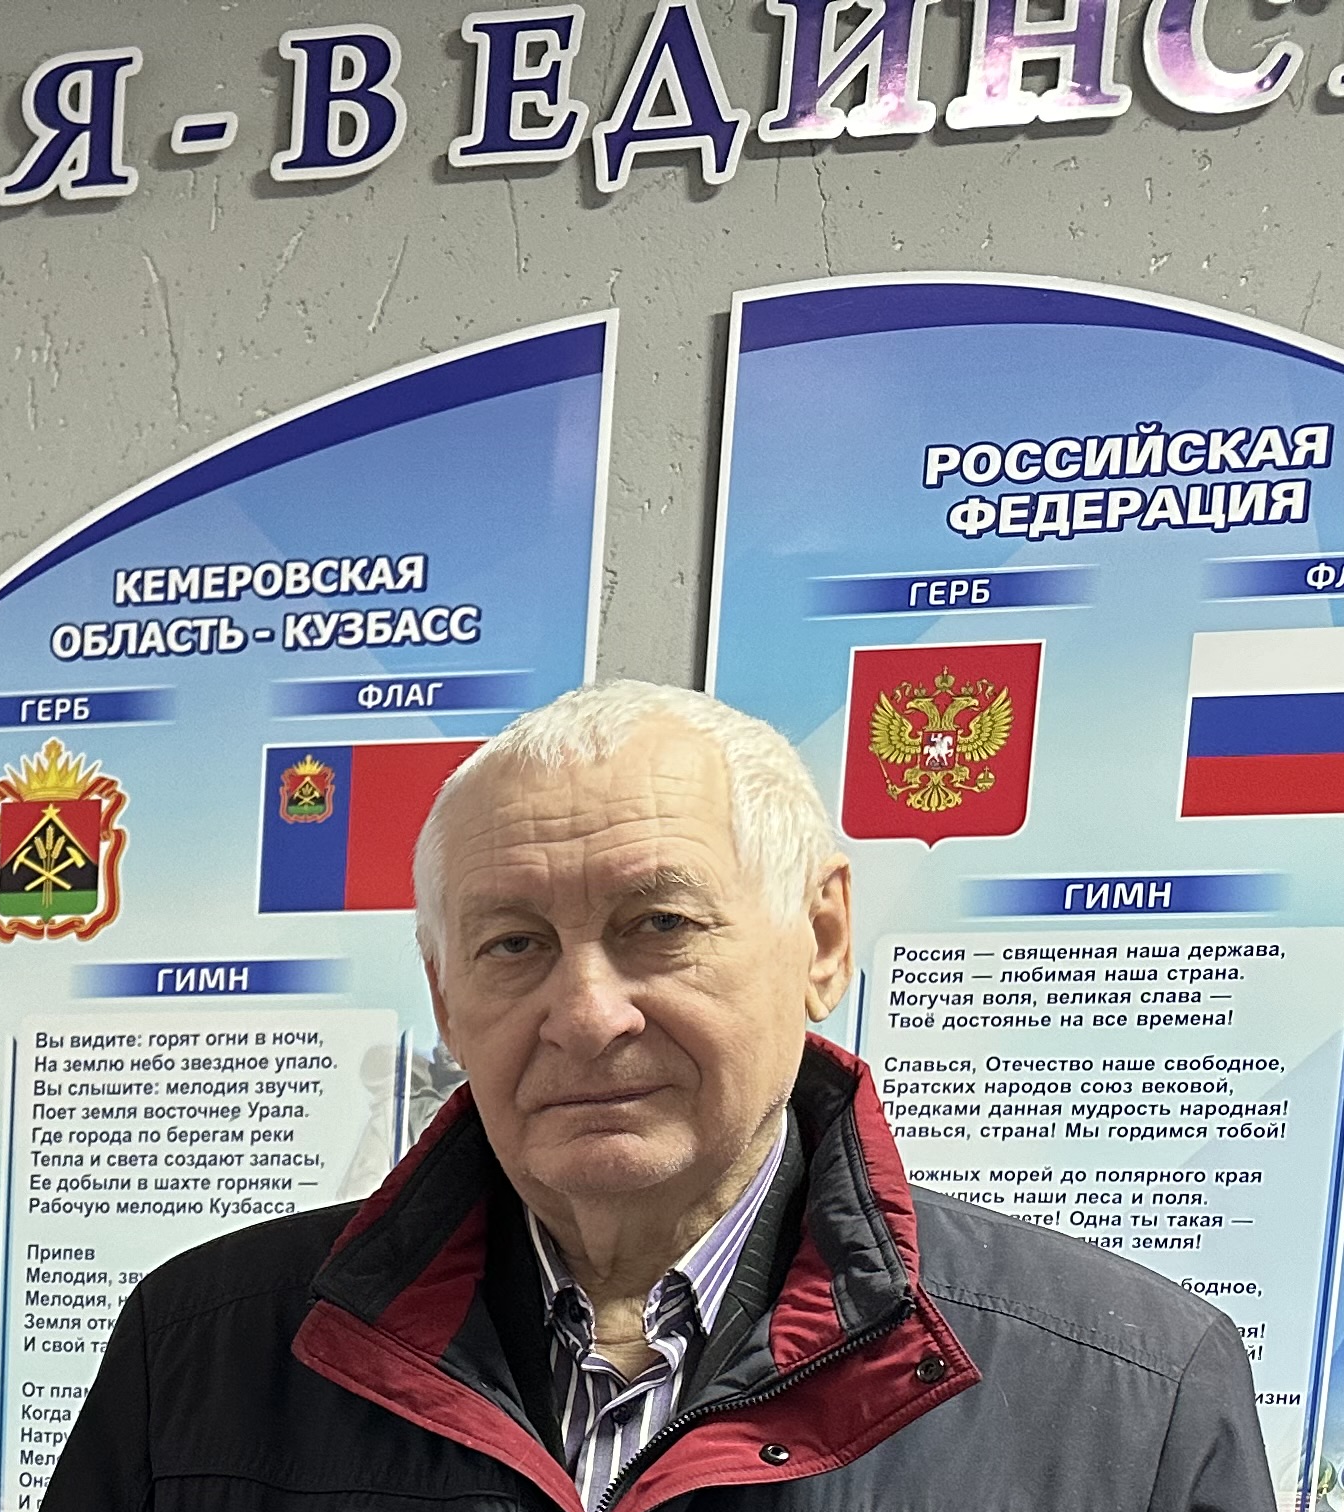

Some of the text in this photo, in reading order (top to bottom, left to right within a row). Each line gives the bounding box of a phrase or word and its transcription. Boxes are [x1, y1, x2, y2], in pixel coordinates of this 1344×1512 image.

[174, 112, 230, 152] -
[278, 22, 408, 180] В
[450, 0, 1344, 190] ЕДИНС
[924, 421, 1333, 486] РОССИЙСКАЯ
[947, 479, 1311, 539] ФЕДЕРАЦИЯ
[114, 555, 425, 603] КЕМЕРОВСКАЯ
[909, 578, 992, 608] ГЕРБ
[52, 615, 245, 660] ОБЛАСТЬ
[282, 606, 480, 650] КУЗБАСС
[357, 681, 443, 709] ФЛАГ
[20, 697, 91, 722] ГЕРБ
[1063, 880, 1173, 910] ГИМН
[892, 945, 966, 962] Россия
[1002, 946, 1118, 962] священная
[1126, 945, 1180, 959] наша
[1187, 944, 1286, 961] держава,
[156, 967, 249, 993] ГИМН
[891, 968, 964, 984] Россия
[1000, 966, 1097, 983] любимая
[1104, 967, 1158, 982] наша
[1166, 966, 1245, 984] страна.
[889, 990, 974, 1009] Могучая
[982, 991, 1038, 1007] воля,
[1046, 991, 1132, 1005] великая
[1140, 989, 1202, 1004] слава
[888, 1009, 1234, 1030] Твоё достоянье на все времена!
[35, 1031, 324, 1051] Вы видите: горят огни в ночи,
[34, 1054, 338, 1074] На землю небо звездное упало.
[884, 1054, 1285, 1075] Славься, Отечество наше свободное,
[33, 1079, 324, 1098] Вы слышите: мелодия звучит,
[882, 1077, 1234, 1098] Братских народов союз вековой,
[32, 1101, 310, 1122] Поет земля восточнее Урала.
[882, 1100, 1289, 1120] Предками данная мудрость народная!
[31, 1126, 295, 1148] Где города по берегам реки
[887, 1121, 1287, 1142] лавься, страна! Мы гордимся тобой!
[30, 1150, 326, 1169] Тепла и света создают запасы,
[29, 1174, 52, 1191] Ее
[56, 1173, 132, 1194] добыли
[137, 1177, 149, 1191] в
[153, 1176, 211, 1191] шахте
[216, 1176, 293, 1195] горняки
[989, 1166, 1054, 1186] морей
[1060, 1169, 1088, 1185] до
[1095, 1169, 1207, 1187] полярного
[1214, 1170, 1264, 1187] края
[28, 1197, 111, 1218] Рабочую
[115, 1200, 204, 1217] мелодию
[1012, 1191, 1067, 1204] наши
[1074, 1192, 1123, 1205] леса
[1131, 1192, 1144, 1205] и
[1151, 1192, 1209, 1206] поля.
[1069, 1210, 1123, 1228] Одна
[1129, 1214, 1158, 1227] ты
[1166, 1214, 1224, 1228] такая
[1131, 1233, 1202, 1250] земля!
[26, 1243, 96, 1264] Припев
[25, 1266, 113, 1287] Мелодия,
[1181, 1277, 1263, 1298] бодное,
[25, 1290, 112, 1309] Мелодия,
[23, 1312, 82, 1330] Земля
[23, 1335, 36, 1353] И
[41, 1335, 85, 1353] свой
[21, 1380, 45, 1398] От
[21, 1403, 72, 1424] Когда
[18, 1493, 31, 1511] И
